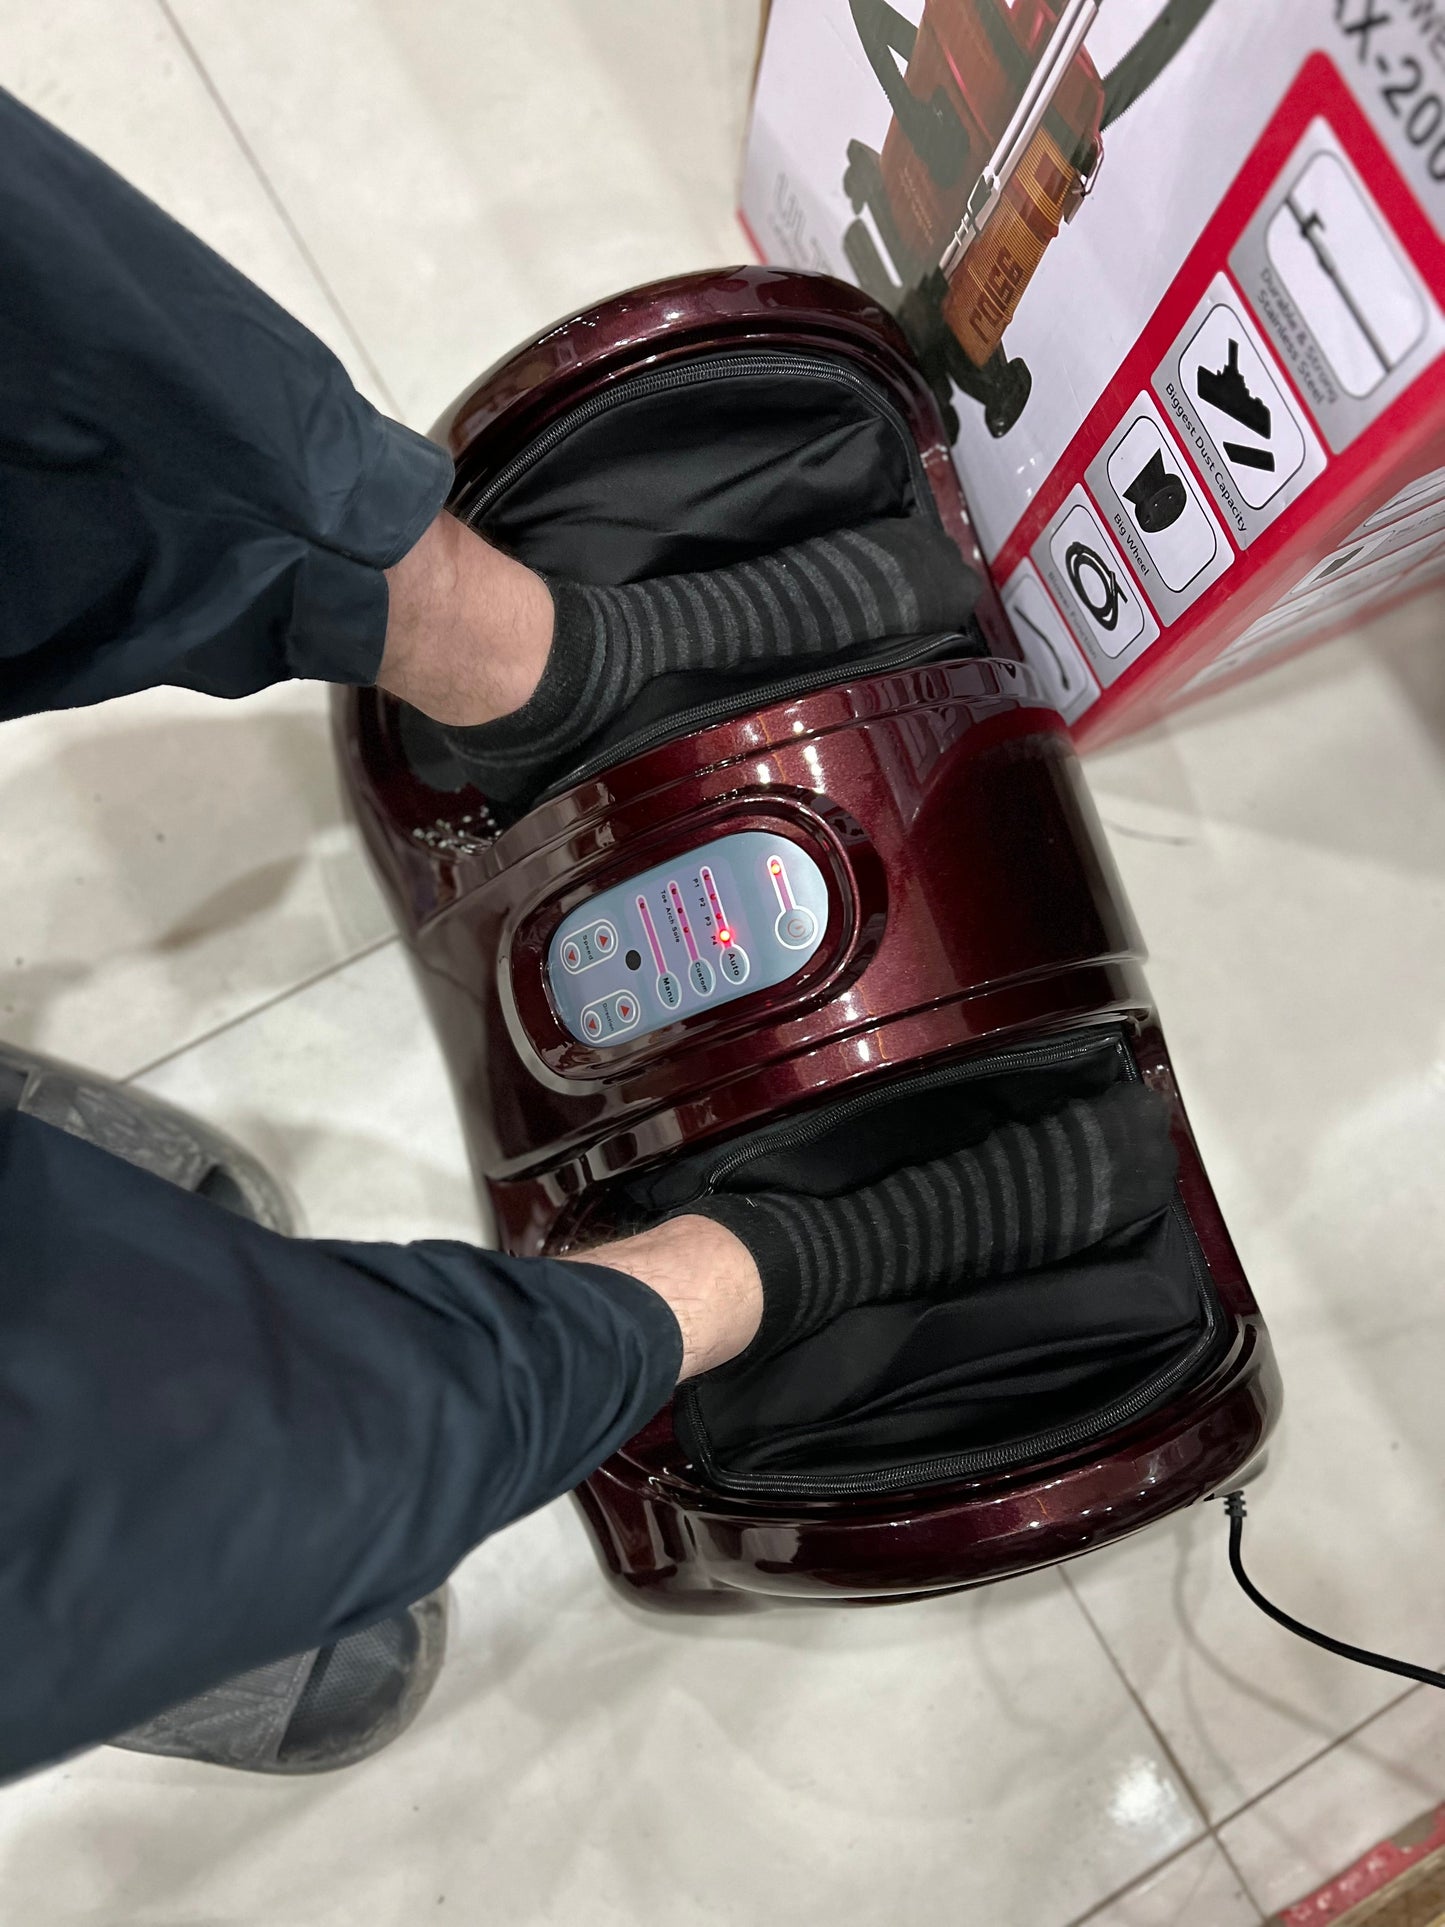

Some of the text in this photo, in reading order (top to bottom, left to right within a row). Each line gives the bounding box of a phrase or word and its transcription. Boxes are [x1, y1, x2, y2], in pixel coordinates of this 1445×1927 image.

[1260, 267, 1297, 331] Durable
[1257, 289, 1325, 405] Stainless Steel
[1165, 382, 1247, 532] Biggest Dust Capacity
[1113, 513, 1151, 577] Big Wheel
[665, 907, 675, 925] Arch
[672, 926, 680, 943] Sole
[693, 878, 718, 945] P1 P2 P3 P4
[582, 934, 594, 960] Speed
[728, 953, 740, 976] Auto
[663, 977, 675, 1003] Manu
[695, 962, 708, 992] Custom
